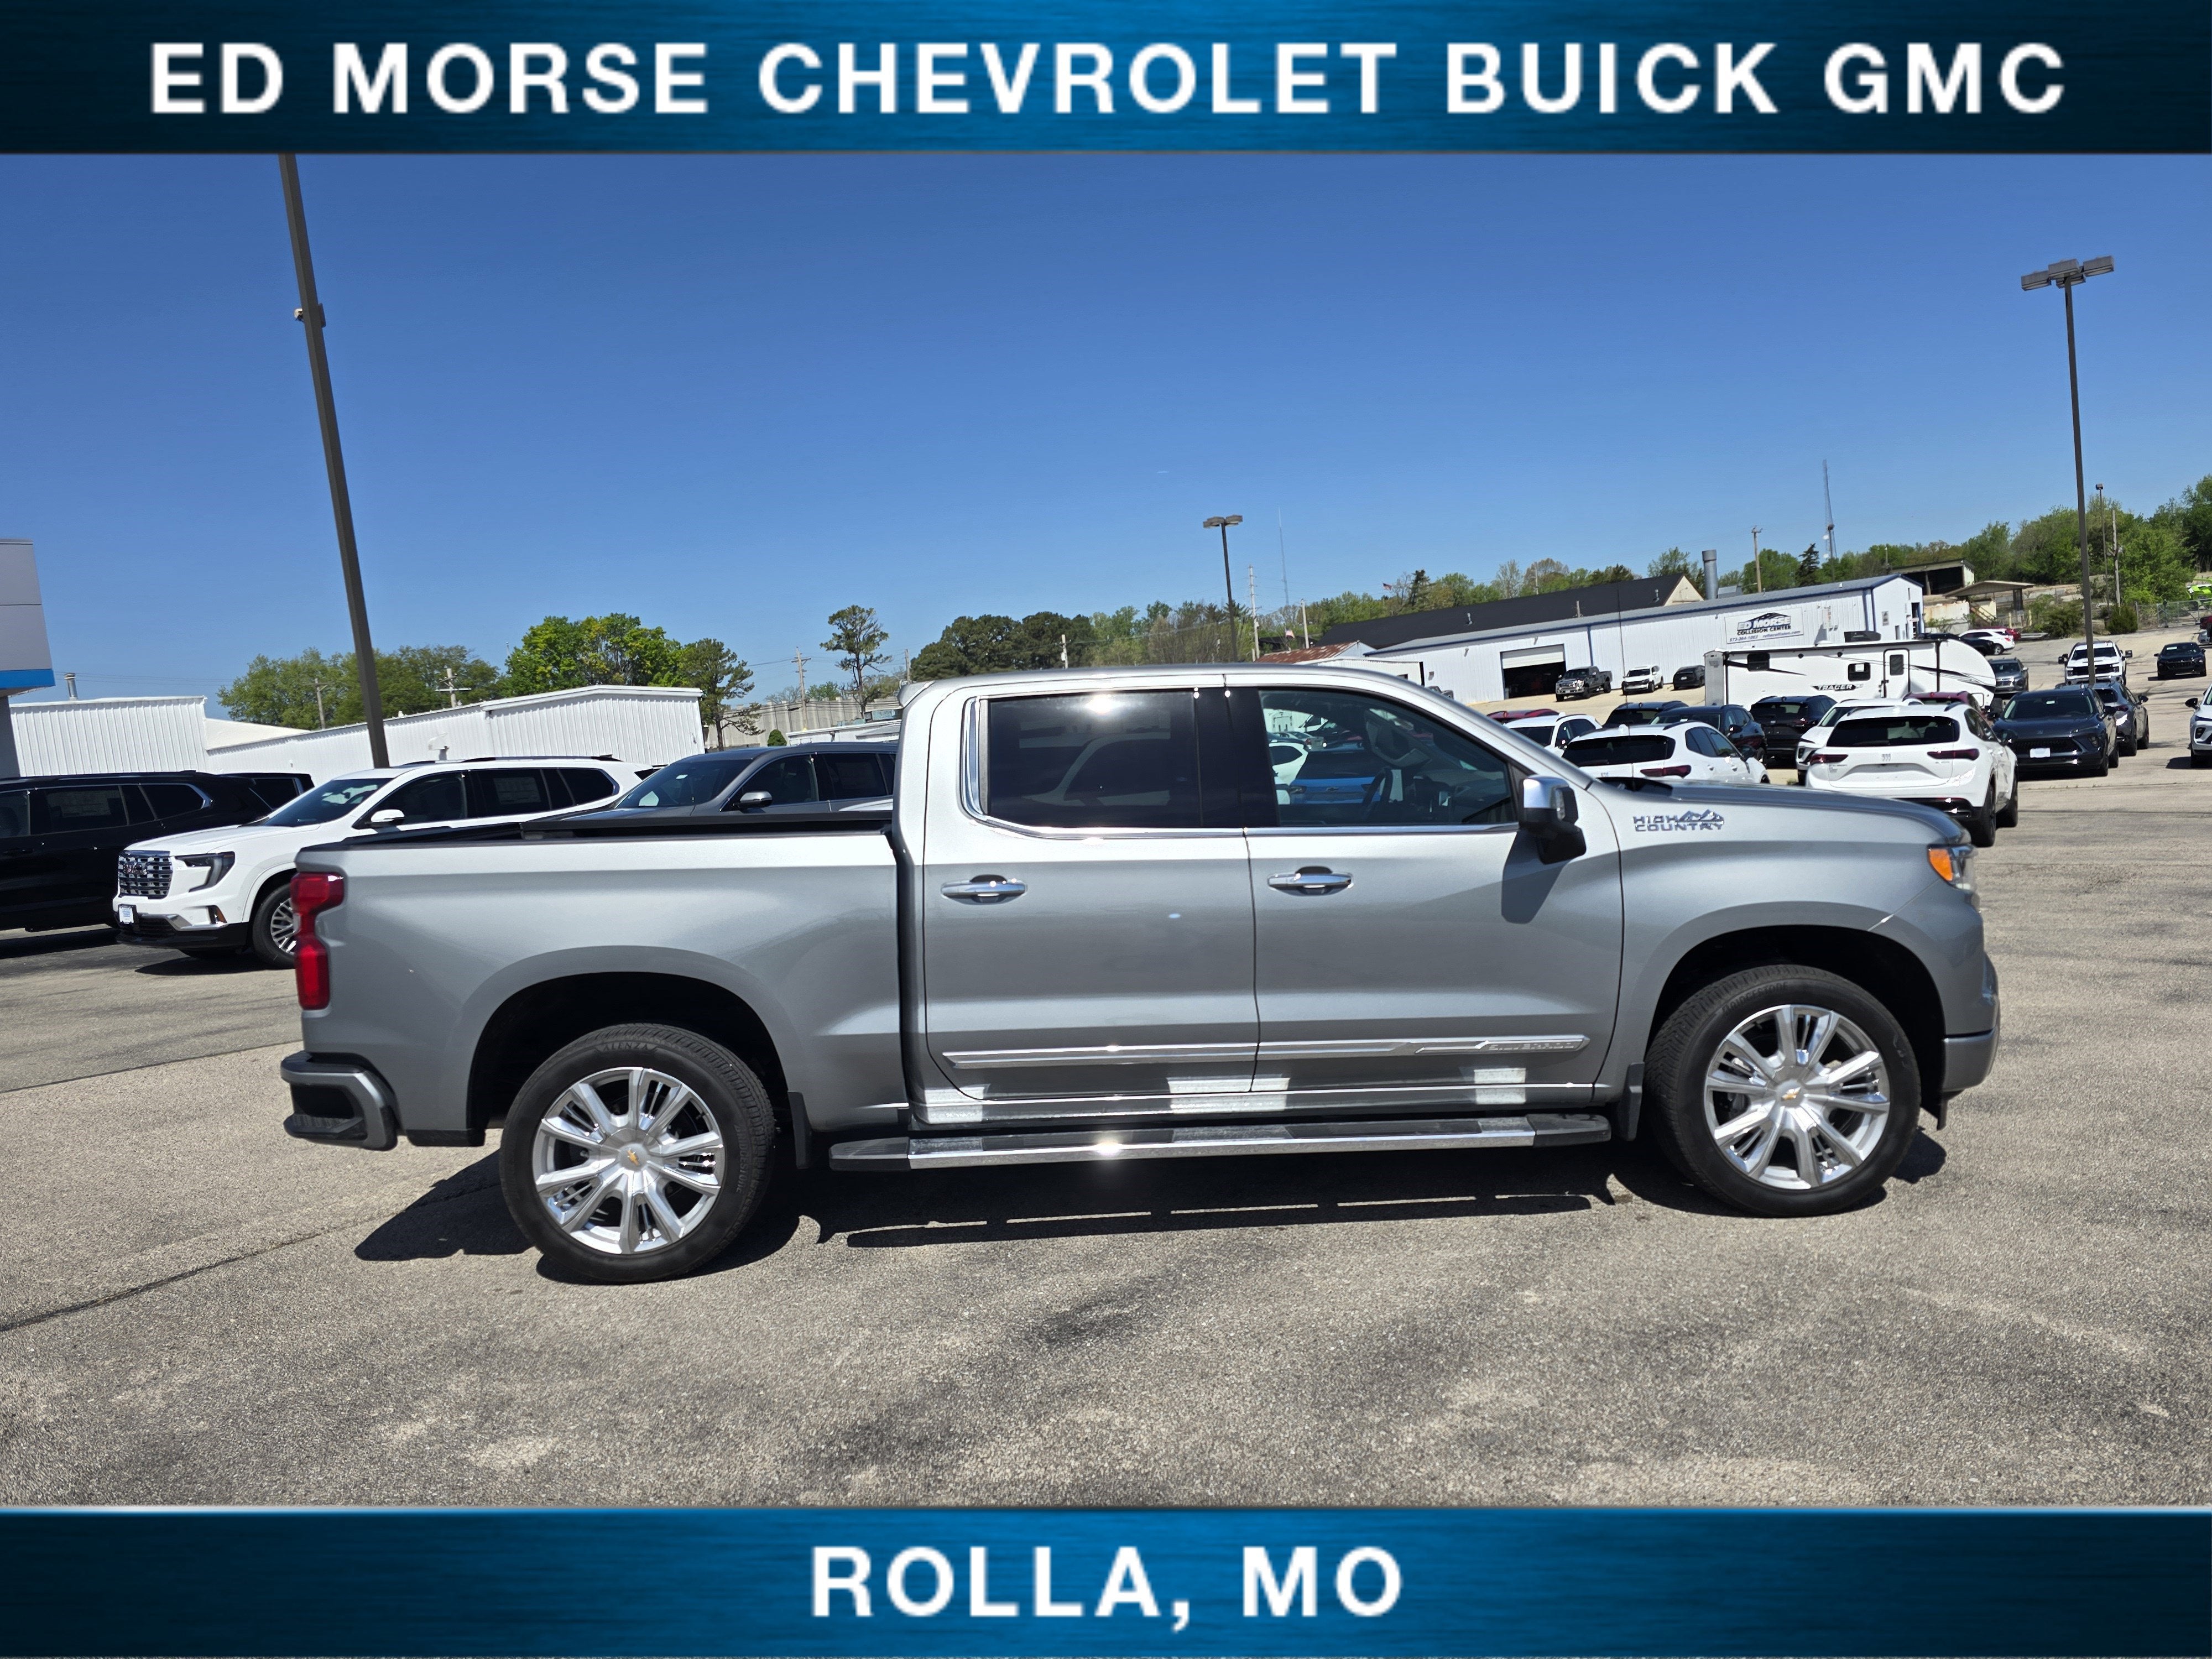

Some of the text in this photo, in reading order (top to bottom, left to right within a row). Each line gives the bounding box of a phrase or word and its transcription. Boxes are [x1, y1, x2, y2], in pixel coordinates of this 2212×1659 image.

[1738, 617, 1791, 630] ED MORSE
[1633, 816, 1679, 824] HIGH
[1635, 823, 1723, 832] COUNTRY
[603, 1042, 649, 1051] ALENZA
